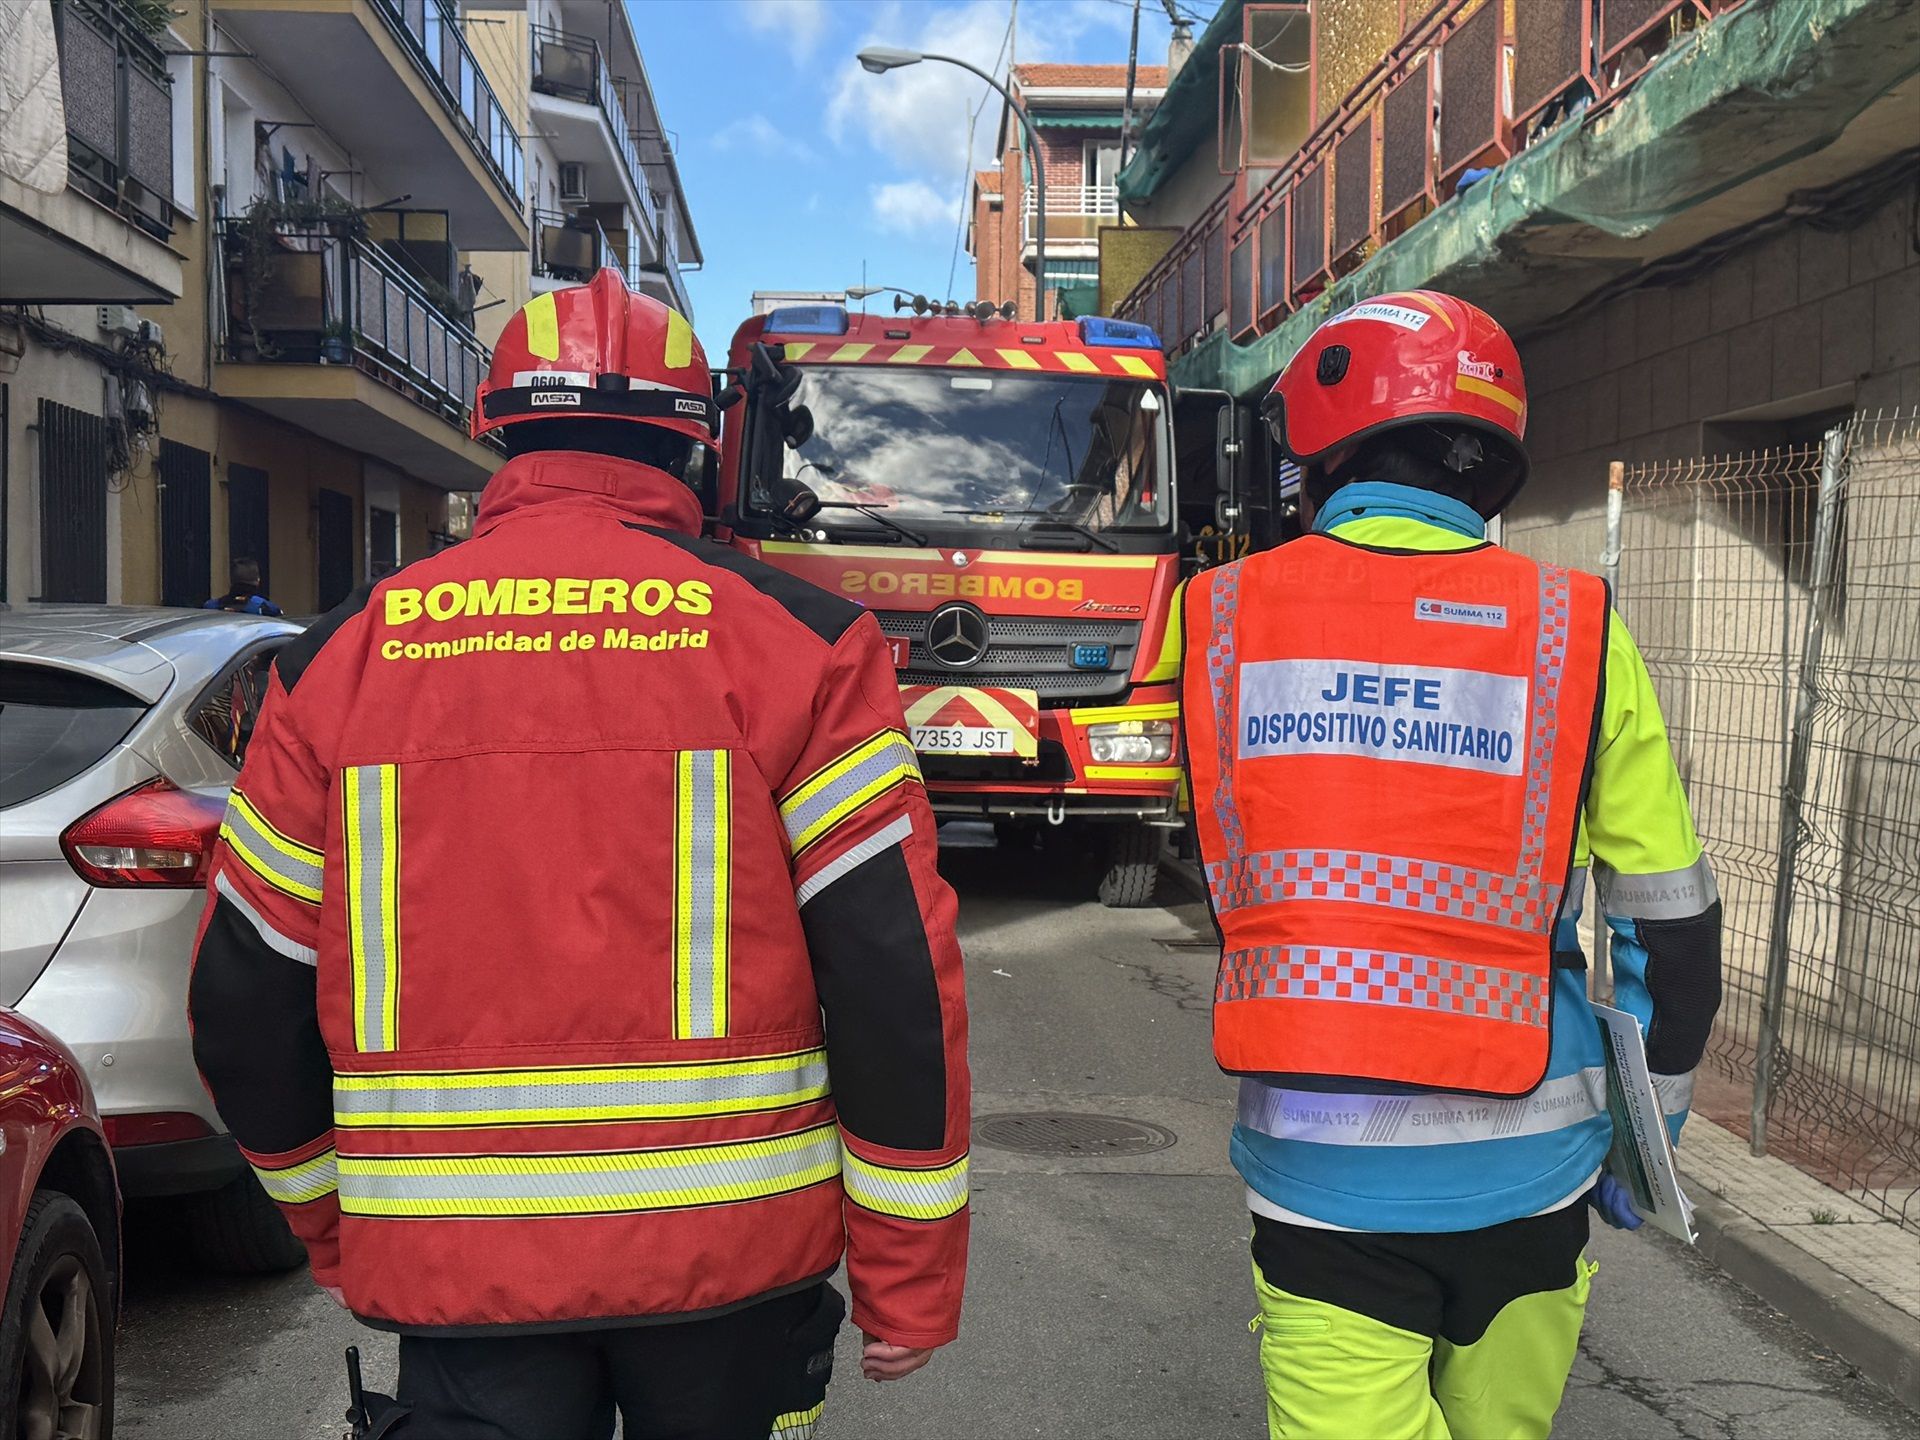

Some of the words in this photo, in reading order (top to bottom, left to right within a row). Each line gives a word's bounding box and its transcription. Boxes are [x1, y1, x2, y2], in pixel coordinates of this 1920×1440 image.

[1356, 305, 1400, 318] SUMMA
[1403, 313, 1425, 325] 112
[533, 394, 577, 403] MSA
[677, 401, 705, 413] MSA
[385, 578, 713, 625] BOMBEROS
[1443, 607, 1483, 618] SUMMA
[1486, 612, 1503, 620] 112
[381, 630, 552, 660] Comunidad
[559, 630, 596, 652] de
[603, 627, 709, 651] Madrid
[1321, 672, 1441, 710] JEFE
[916, 730, 963, 748] 7353
[973, 731, 1008, 749] JST
[1247, 712, 1386, 748] DISPOSITIVO
[1392, 718, 1513, 763] SANITARIO
[1282, 1107, 1333, 1125] SUMMA
[1336, 1111, 1360, 1126] 112
[1411, 1110, 1465, 1127] SUMMA
[1467, 1107, 1490, 1123] 112
